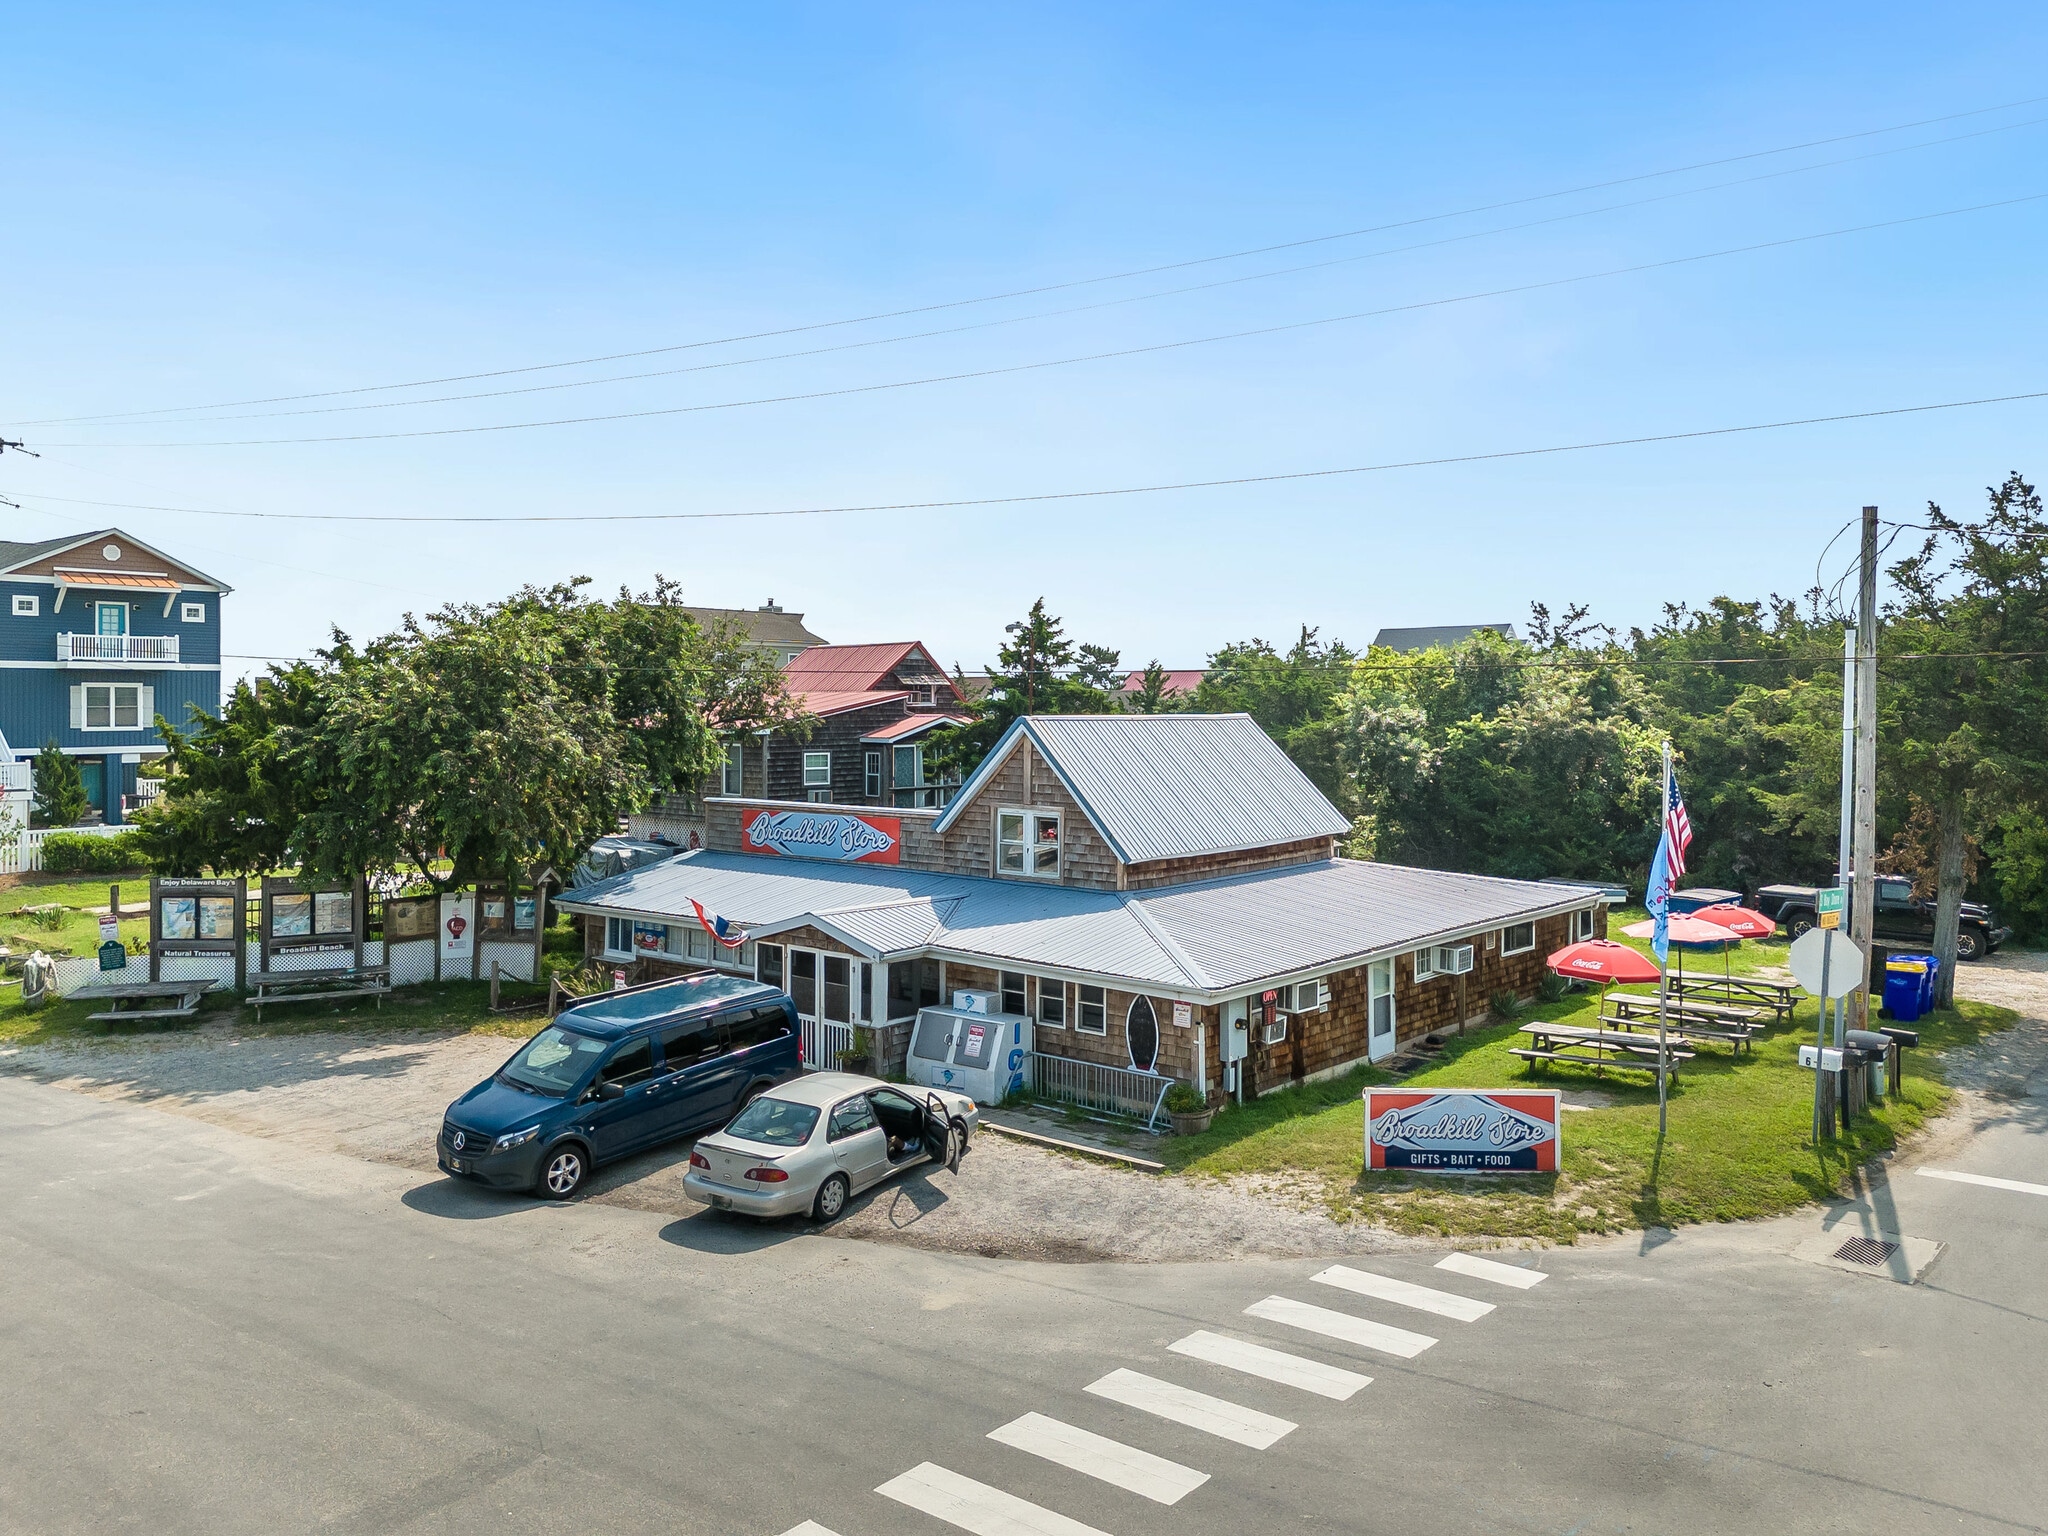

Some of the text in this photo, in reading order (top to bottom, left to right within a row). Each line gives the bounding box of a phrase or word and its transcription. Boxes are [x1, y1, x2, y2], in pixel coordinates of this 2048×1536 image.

[751, 812, 889, 852] Broadkill Store
[160, 879, 180, 887] Enjoy
[216, 879, 236, 887] Bay's
[280, 945, 317, 954] Broadkill
[1262, 989, 1278, 1003] OPEN
[1376, 1111, 1545, 1145] Broadkill Store
[1410, 1153, 1511, 1166] GIFTS BAIT FOOD
